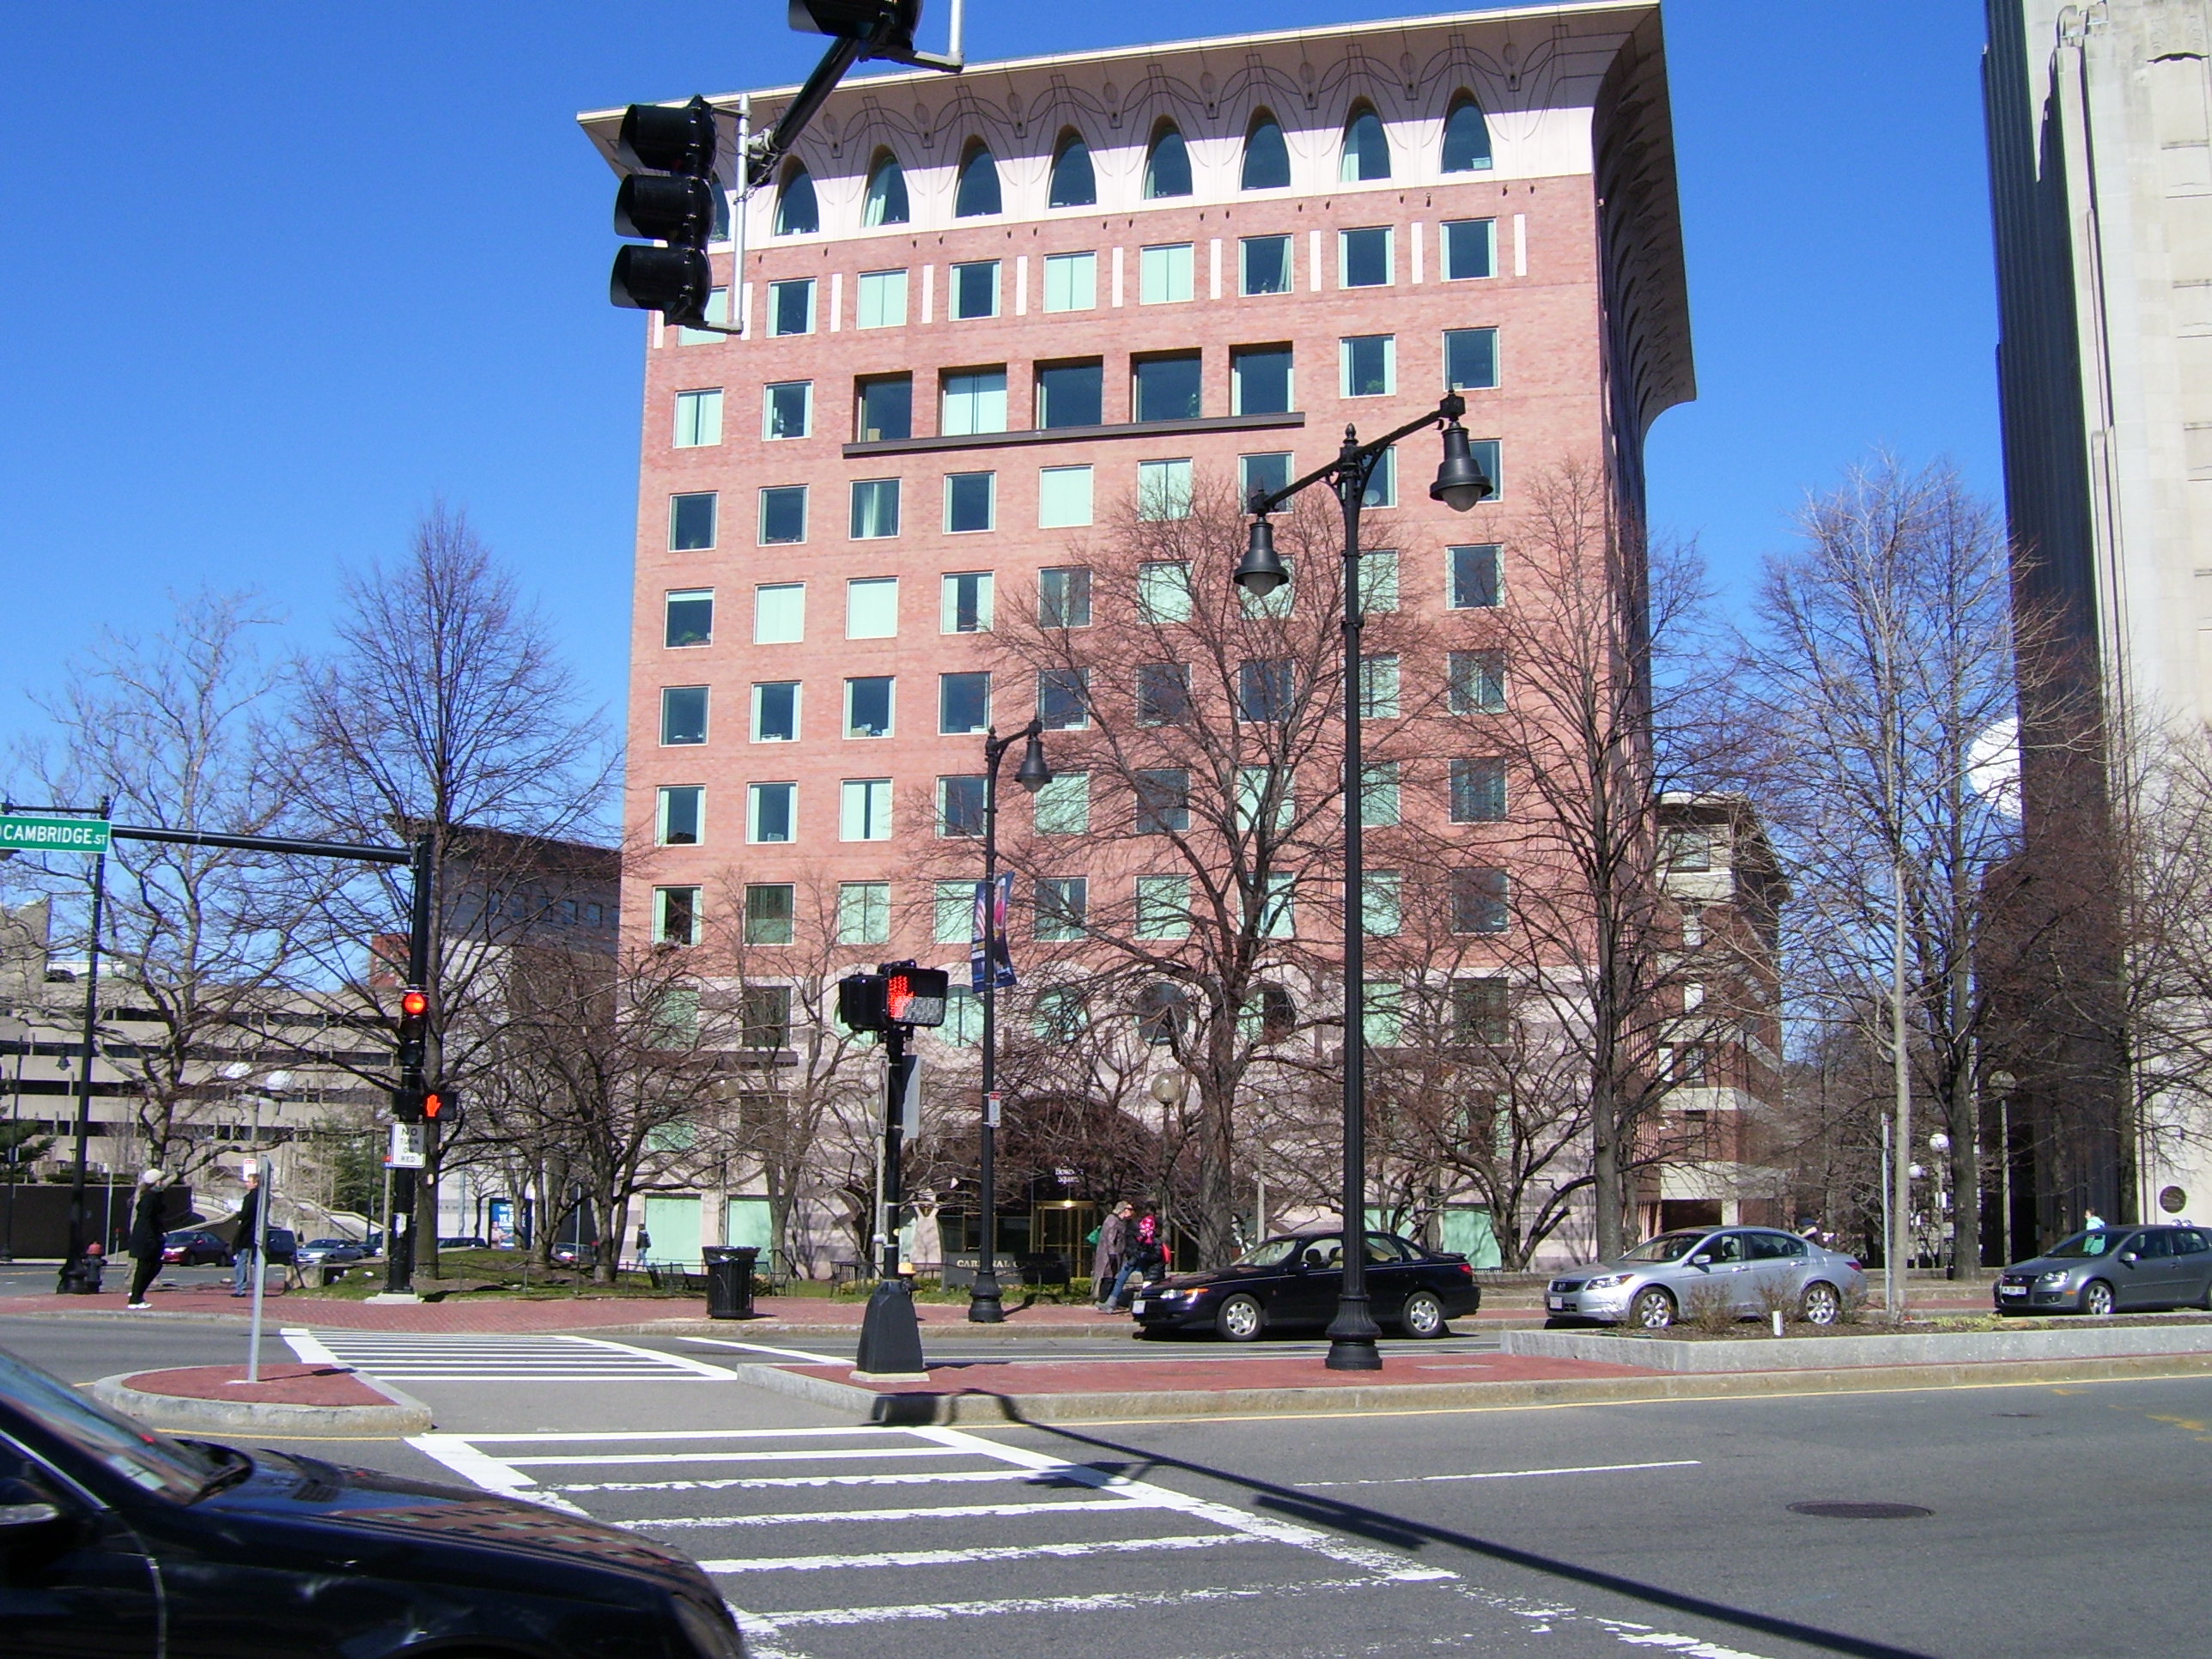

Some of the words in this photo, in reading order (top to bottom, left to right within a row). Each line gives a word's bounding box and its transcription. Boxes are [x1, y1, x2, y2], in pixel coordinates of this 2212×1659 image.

[3, 824, 93, 844] CAMBRIDGE
[94, 834, 106, 845] ST
[401, 1127, 418, 1136] NO
